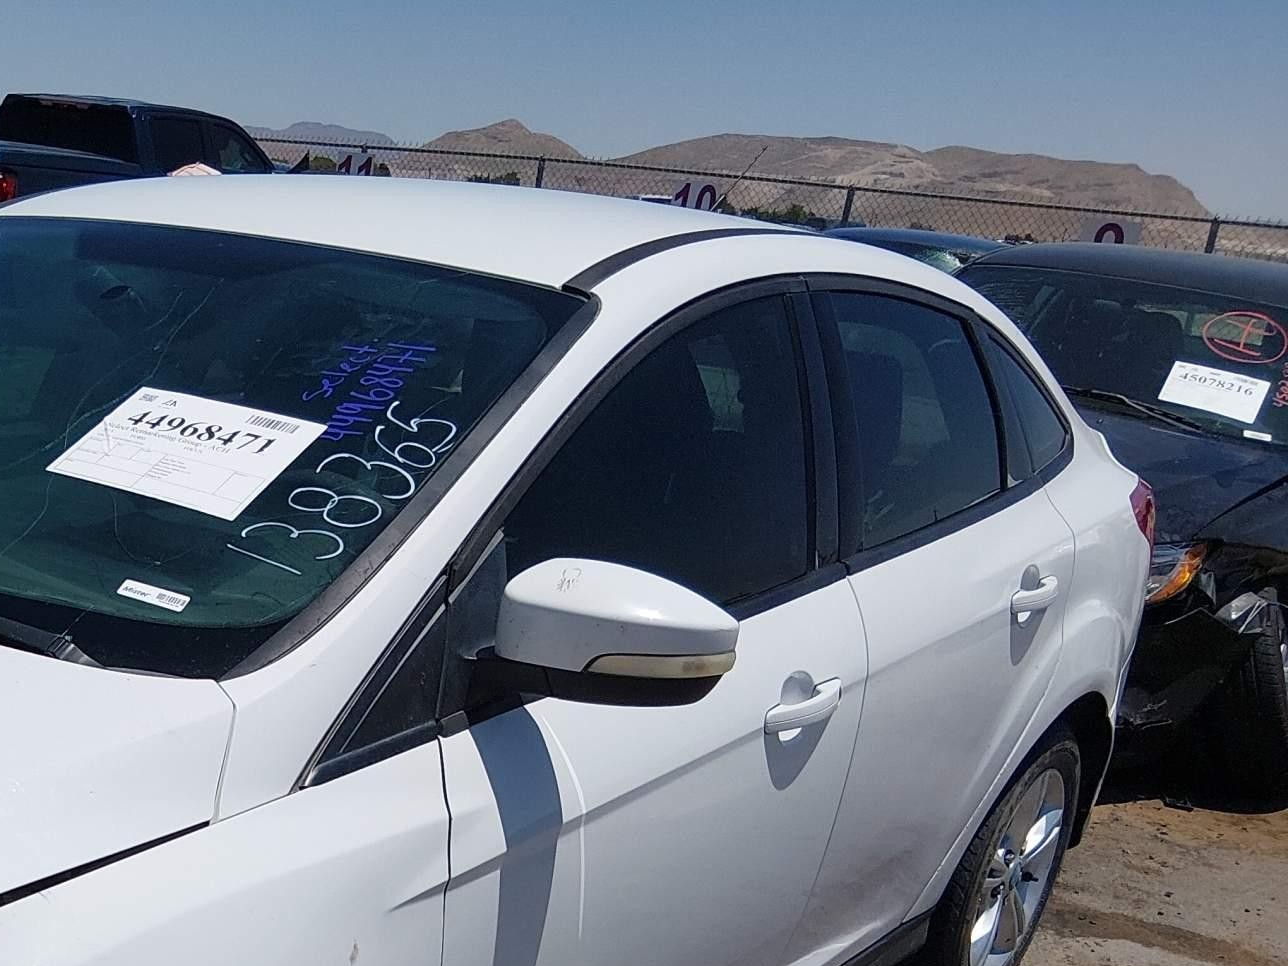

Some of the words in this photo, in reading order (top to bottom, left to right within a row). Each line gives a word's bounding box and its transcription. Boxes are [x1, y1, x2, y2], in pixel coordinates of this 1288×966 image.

[674, 183, 716, 211] 10
[320, 343, 436, 440] 44968471
[1179, 373, 1253, 397] 45078216
[127, 410, 278, 455] 44968471
[227, 401, 457, 575] 138365
